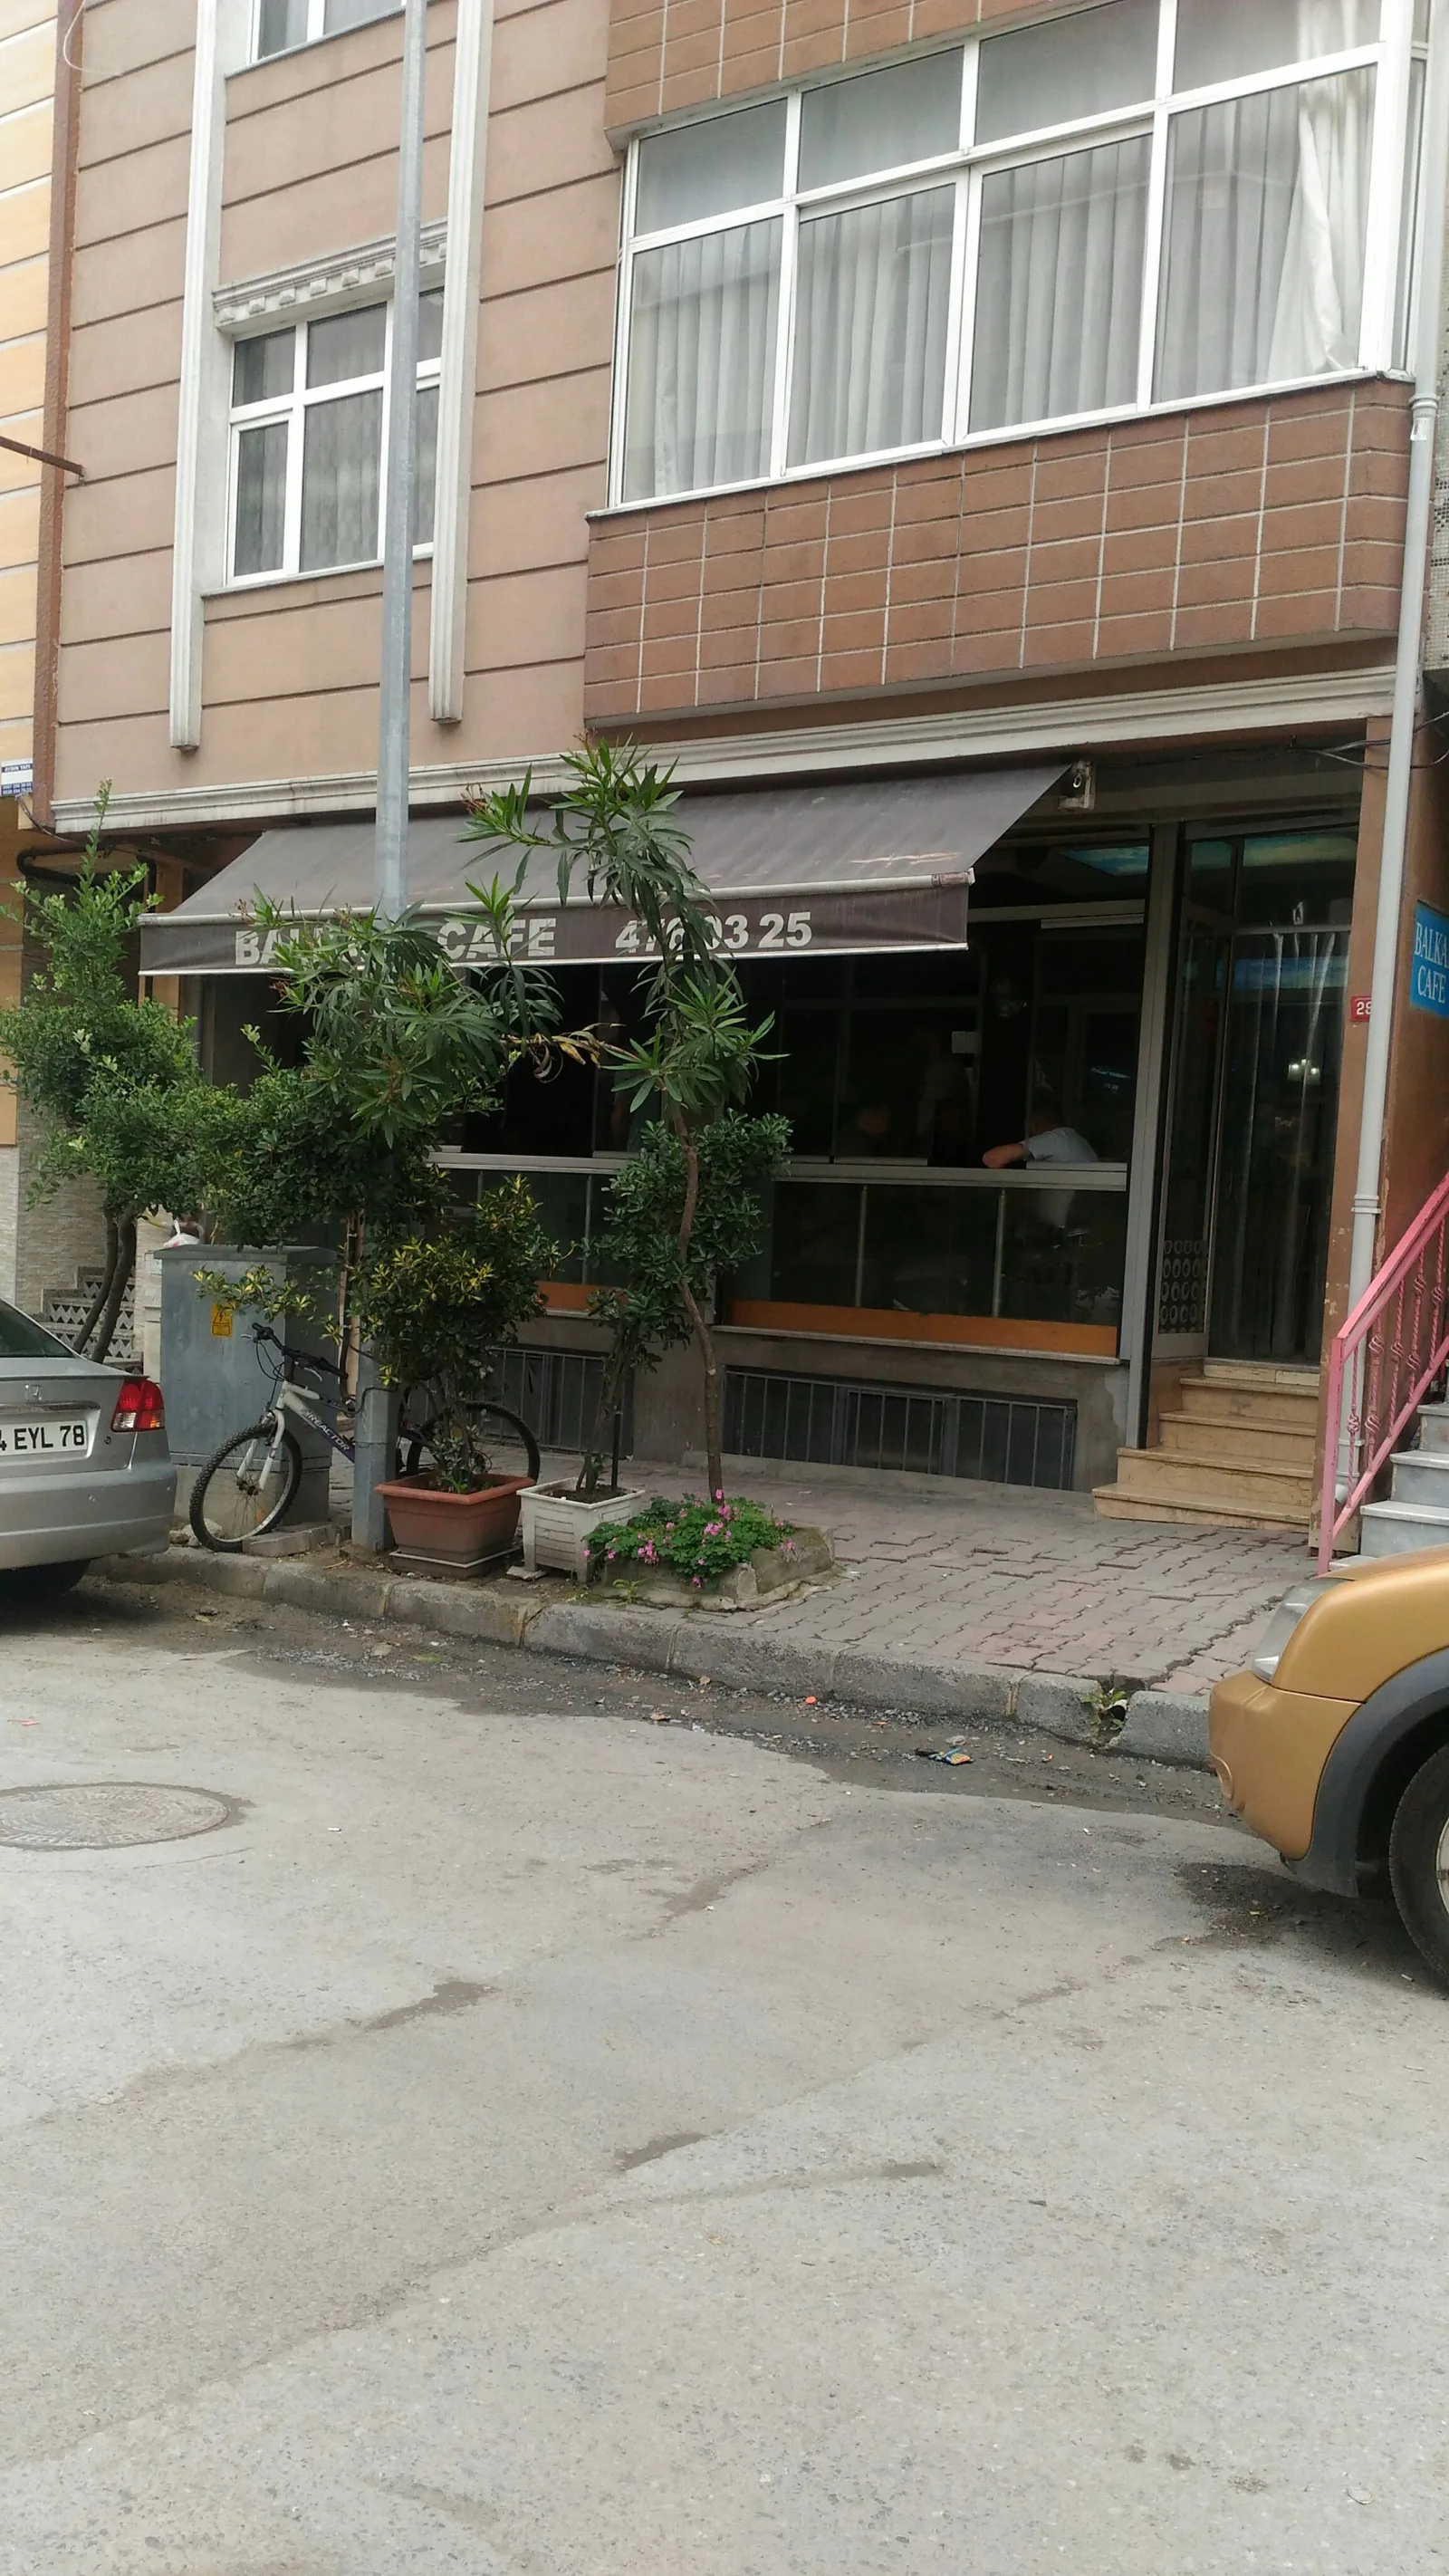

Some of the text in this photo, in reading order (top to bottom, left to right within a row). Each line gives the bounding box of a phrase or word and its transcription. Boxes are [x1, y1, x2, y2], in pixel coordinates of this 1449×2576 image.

[437, 918, 556, 960] CAFE
[758, 911, 812, 948] 25
[1418, 966, 1446, 1004] CAFE
[14, 1427, 53, 1450] EYL
[60, 1425, 85, 1447] 78
[308, 1414, 350, 1451] REACTOR
